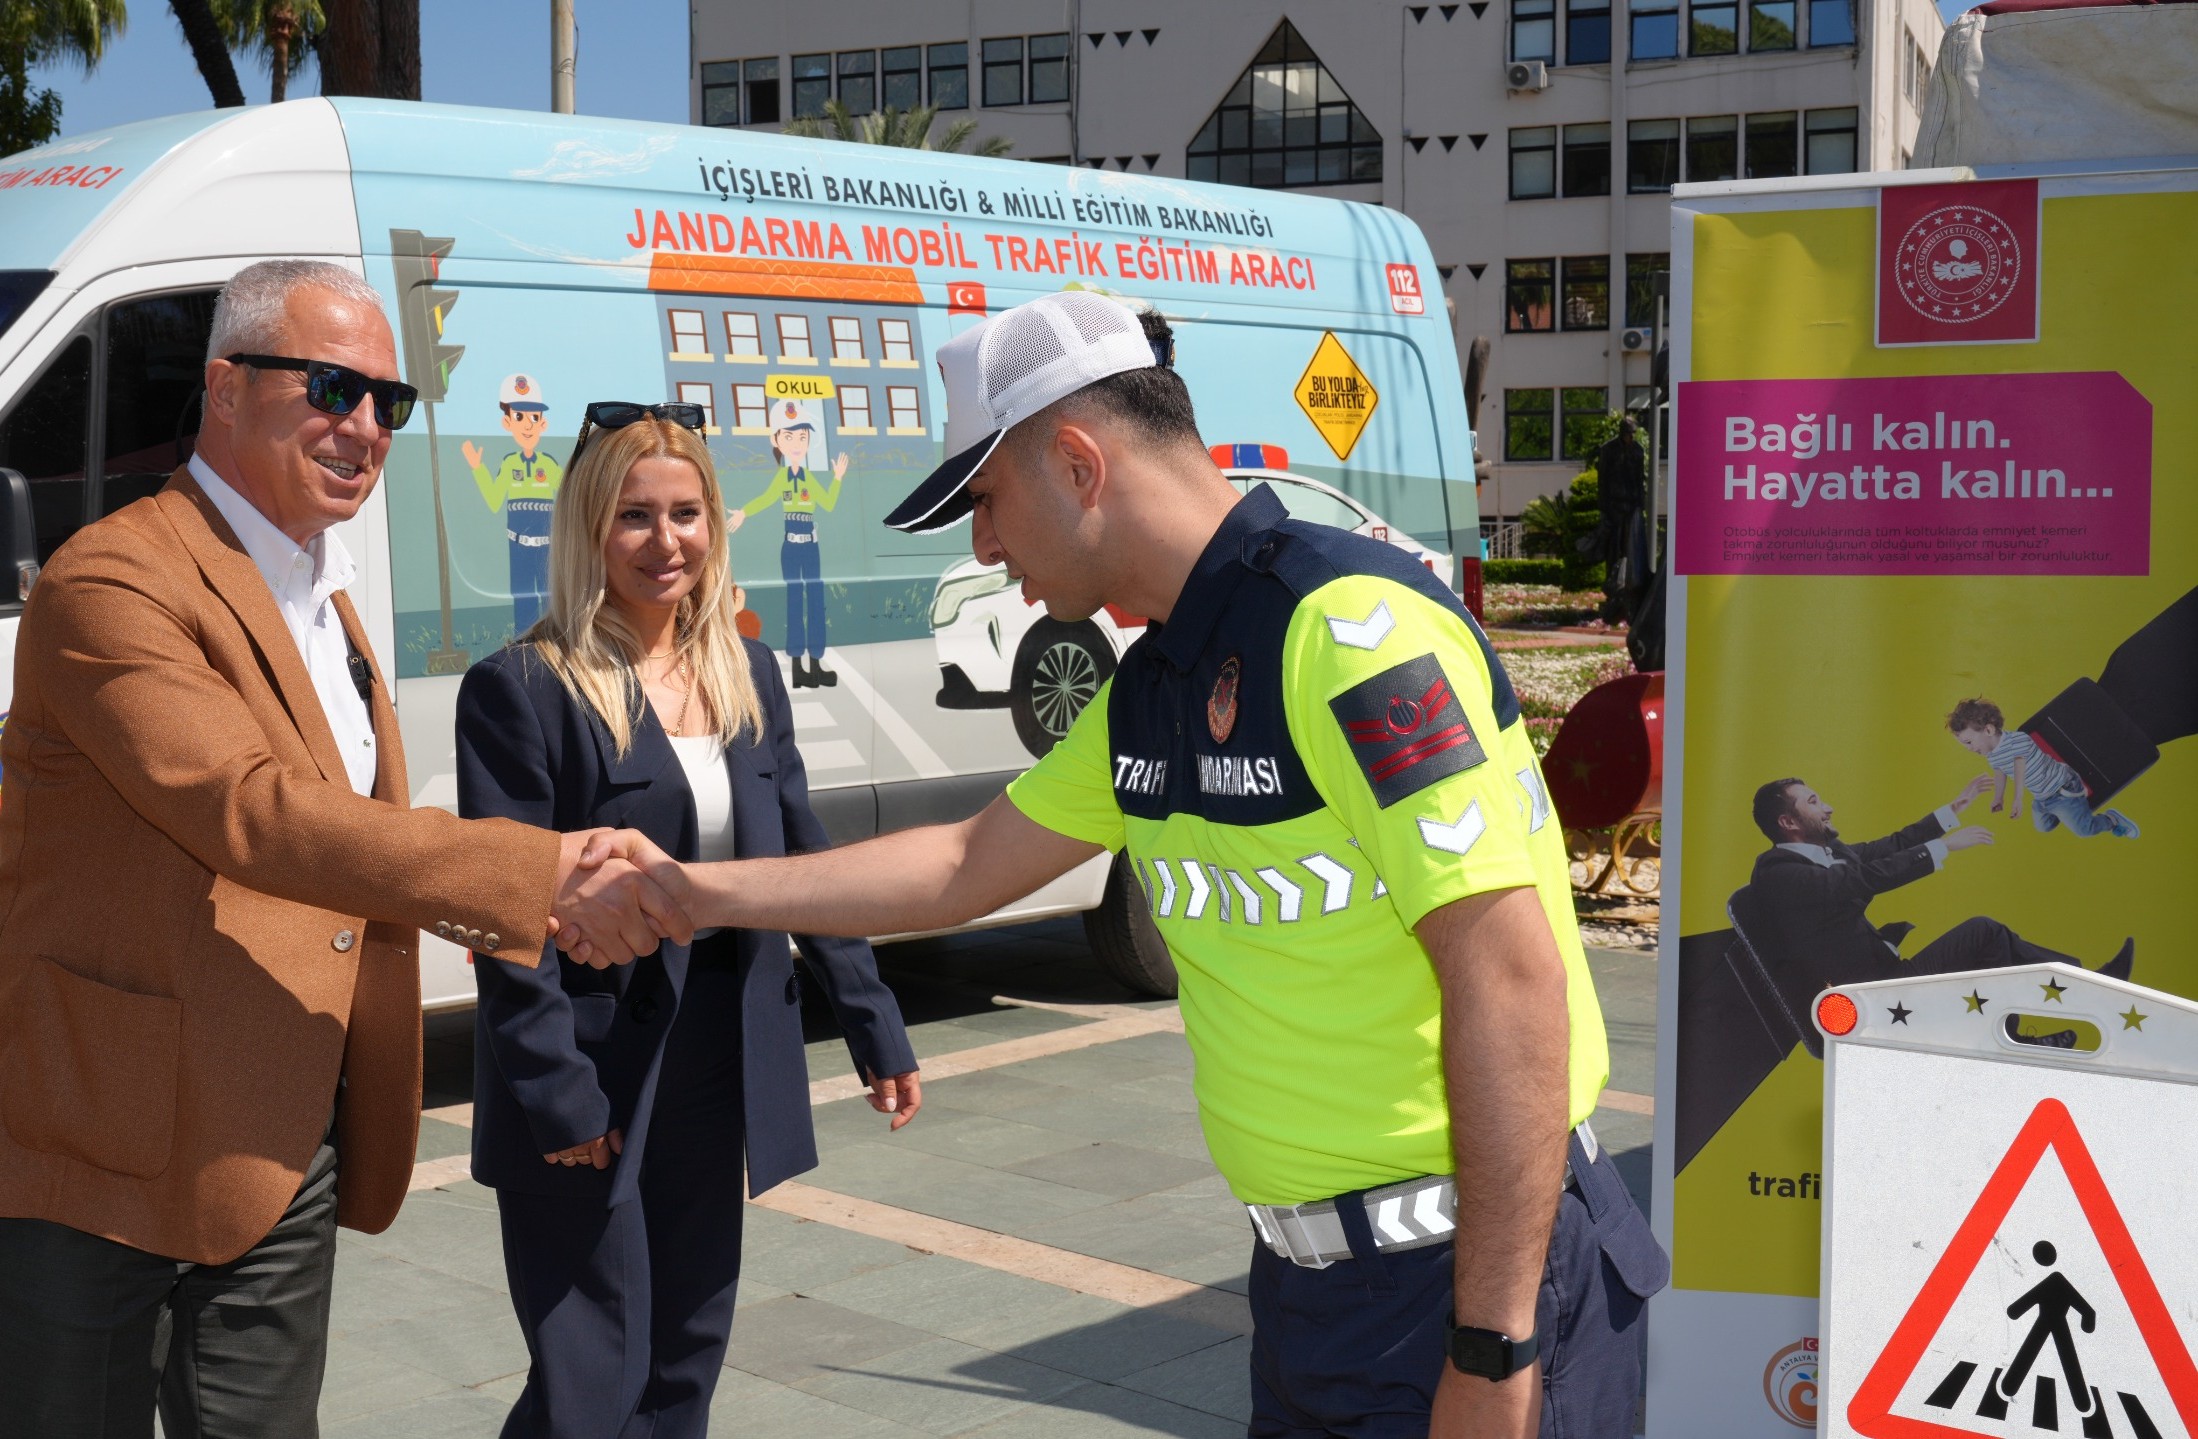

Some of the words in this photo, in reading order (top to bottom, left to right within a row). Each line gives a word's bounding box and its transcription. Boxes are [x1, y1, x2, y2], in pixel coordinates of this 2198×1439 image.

[21, 165, 124, 189] ARACI
[699, 157, 814, 204] İÇİŞLERİ
[823, 175, 968, 213] BAKANLIĞI
[978, 191, 996, 215] &
[1005, 186, 1066, 221] MİLLİ
[1072, 195, 1152, 227] EĞİTİM
[1161, 206, 1274, 238] BAKANLIĞI
[626, 208, 853, 261] JANDARMA
[861, 221, 978, 269] MOBİL
[985, 231, 1109, 277] TRAFİK
[1115, 236, 1220, 284] EĞİTİM
[1230, 252, 1316, 291] ARACI
[1918, 227, 1963, 266] CUMHURİYETİ
[1965, 226, 1995, 253] İÇİŞLERİ
[1390, 269, 1417, 293] 112
[1918, 266, 1941, 298] TÜRKİYE
[776, 380, 823, 395] OKUL
[1312, 375, 1326, 391] BU
[1327, 376, 1358, 392] YOLDA
[1308, 392, 1366, 409] BİRLİKTEYİZ
[1725, 412, 1852, 459] Bağlı
[1873, 411, 2011, 452] kalın.
[1723, 464, 1921, 508] Hayatta
[1941, 460, 2114, 499] kalın...
[1774, 526, 1871, 538] yolculuklarında
[1876, 527, 1900, 537] tüm
[1905, 526, 1978, 537] koltuklarda
[1982, 526, 2037, 538] emniyet
[2041, 525, 2087, 536] kemeri
[1723, 539, 1763, 549] takma
[1766, 539, 1866, 551] zorunluluğunun
[1870, 539, 1932, 551] olduğunu
[1936, 538, 1977, 550] biliyor
[1981, 538, 2049, 549] musunuz?
[1723, 551, 1775, 562] Emniyet
[1826, 551, 1873, 562] takmak
[1877, 551, 1910, 563] yasal
[1915, 554, 1929, 562] ve
[1933, 551, 1994, 563] yaşamsal
[1998, 551, 2015, 562] bir
[1114, 754, 1168, 795] TRAFİ
[1196, 754, 1284, 796] NDARMASI
[1748, 1171, 1821, 1200] trafi
[1780, 1354, 1812, 1372] ANTALYA
